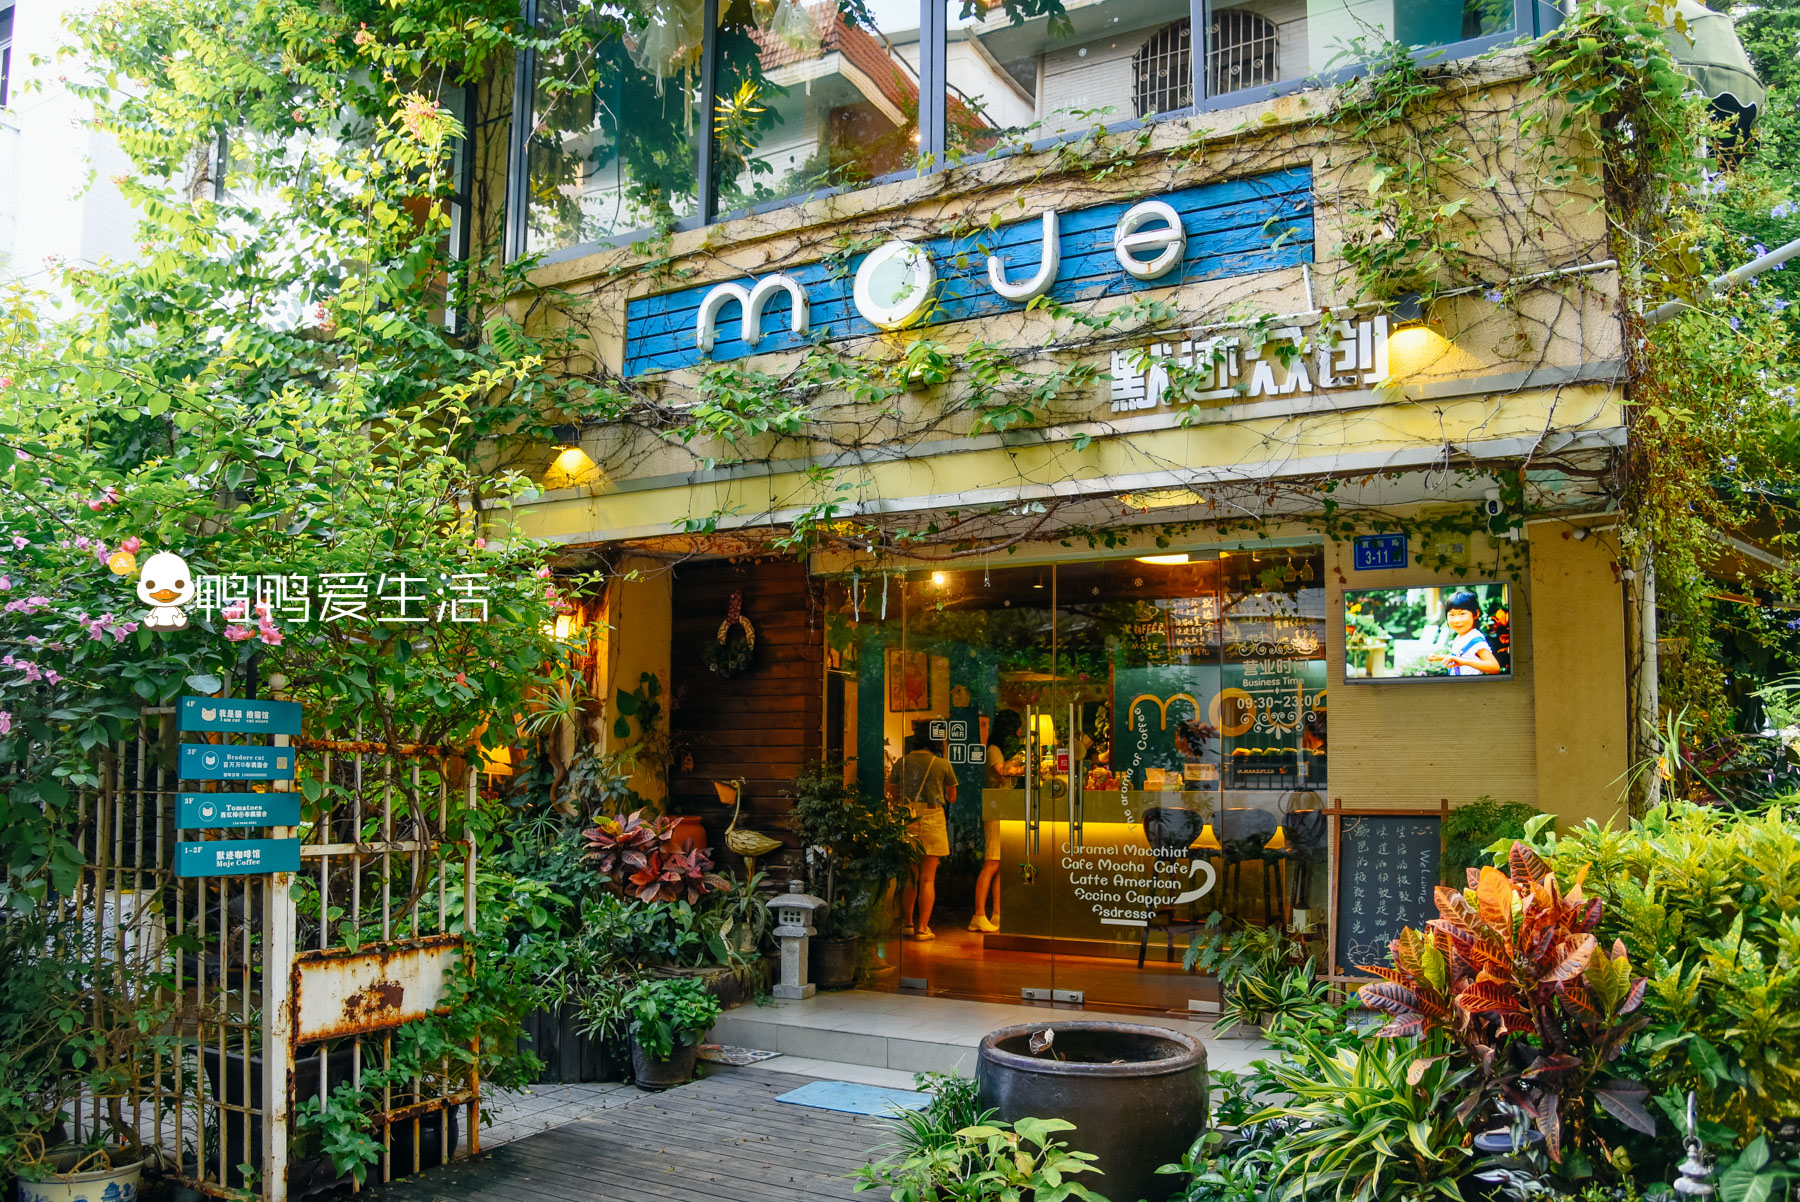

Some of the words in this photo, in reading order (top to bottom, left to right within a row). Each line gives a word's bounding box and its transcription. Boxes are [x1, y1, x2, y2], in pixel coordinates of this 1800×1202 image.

[1243, 658, 1309, 676] 营业时间
[1243, 679, 1280, 687] Business
[1282, 677, 1304, 685] Time
[219, 709, 242, 718] 我是猫
[1134, 707, 1148, 751] Coffee
[1132, 752, 1142, 766] of
[1121, 768, 1134, 806] aroma
[216, 849, 261, 860] 默迹咖啡馆
[1061, 842, 1118, 855] Caramel
[216, 860, 234, 868] Moje
[1061, 857, 1093, 870] Cafe
[1098, 859, 1145, 872] Mocha
[1154, 861, 1188, 874] Cafe
[1069, 872, 1108, 886] Latte
[1113, 874, 1182, 889] American
